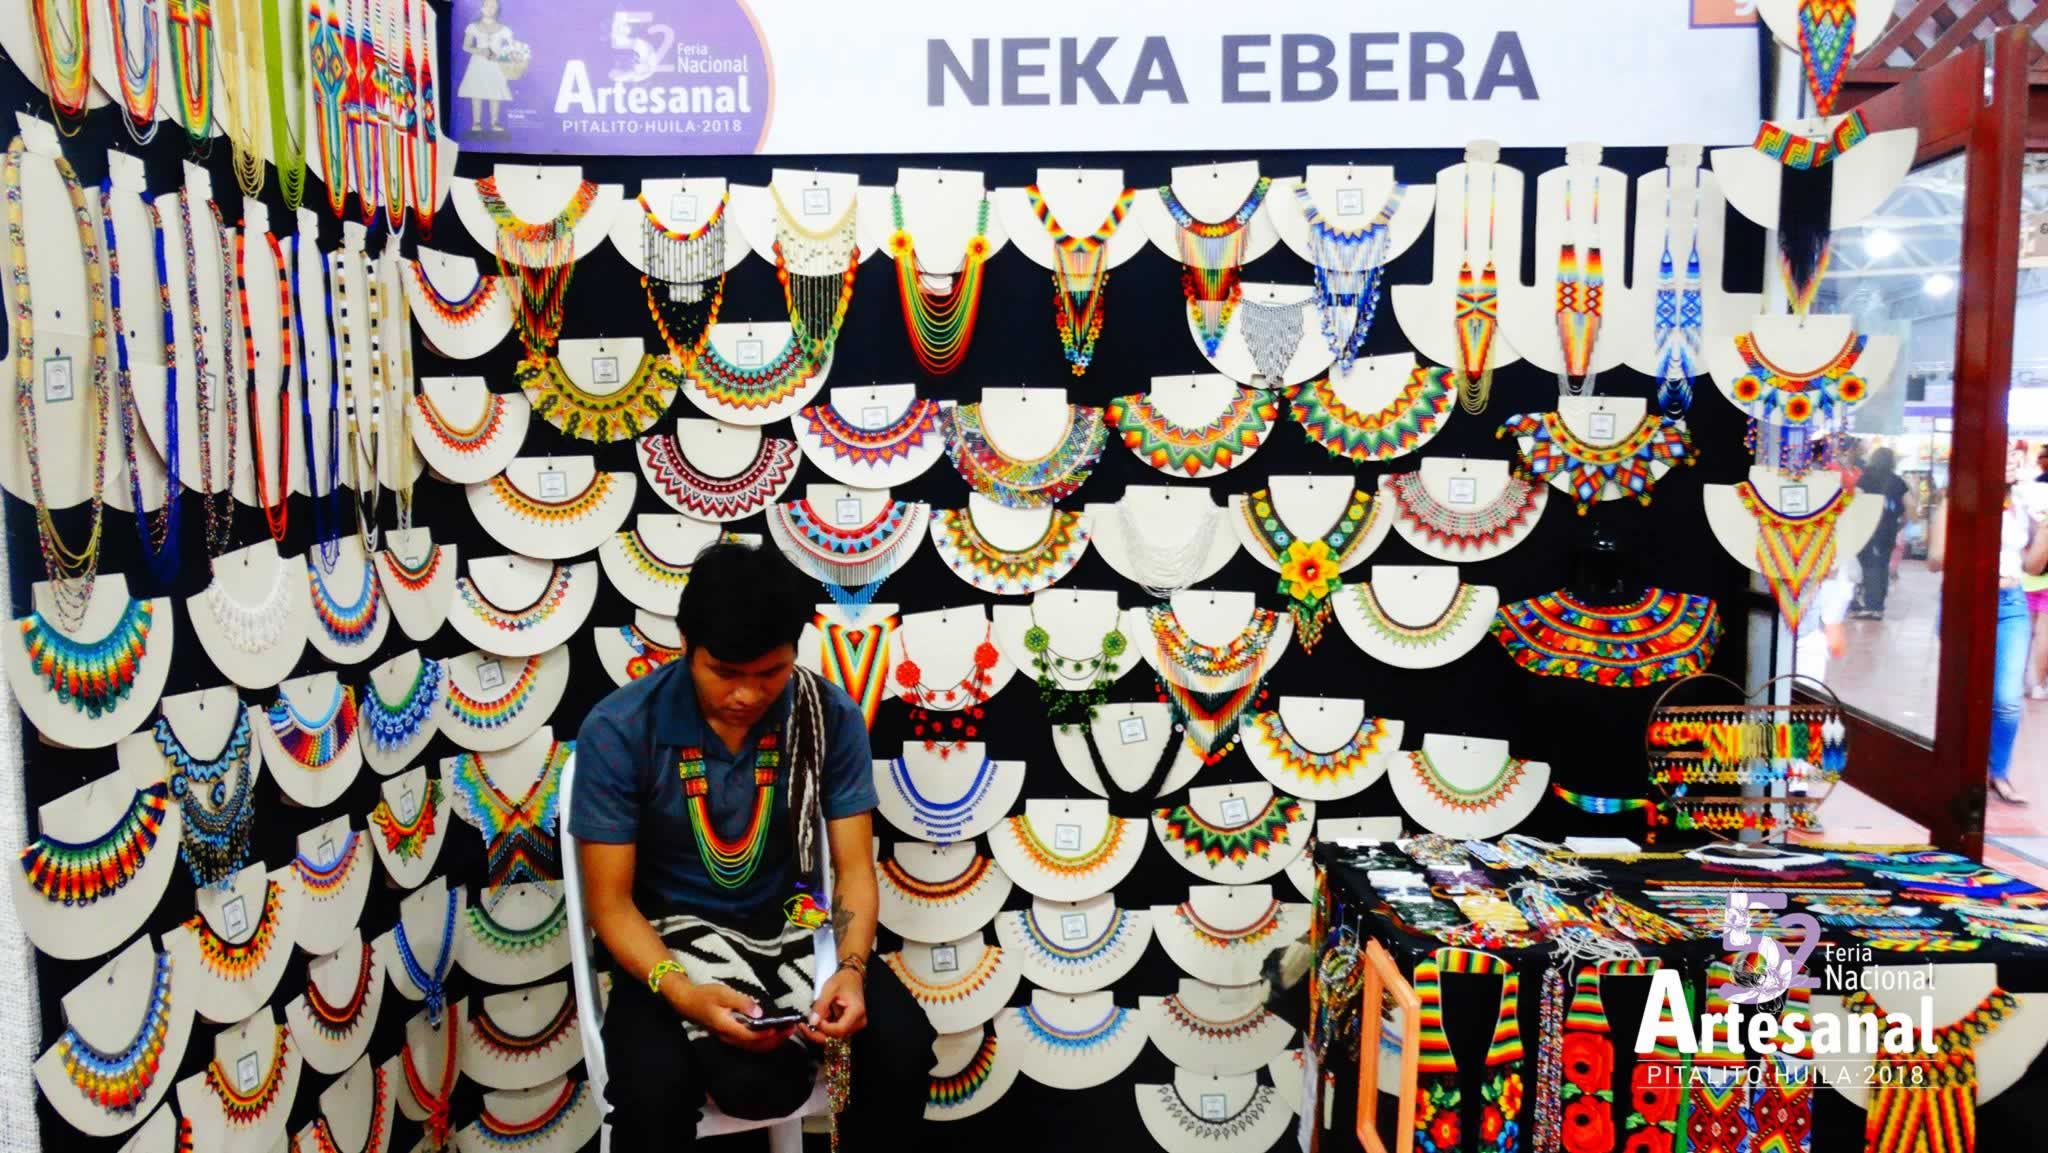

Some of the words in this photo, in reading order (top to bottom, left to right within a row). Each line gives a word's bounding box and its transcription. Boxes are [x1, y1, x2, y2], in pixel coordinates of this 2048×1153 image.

[608, 11, 675, 82] 52
[677, 42, 709, 56] Feria
[677, 54, 749, 73] Nacional
[926, 37, 1189, 107] NEKA
[1221, 30, 1541, 103] EBERA
[554, 59, 752, 114] Artesanal
